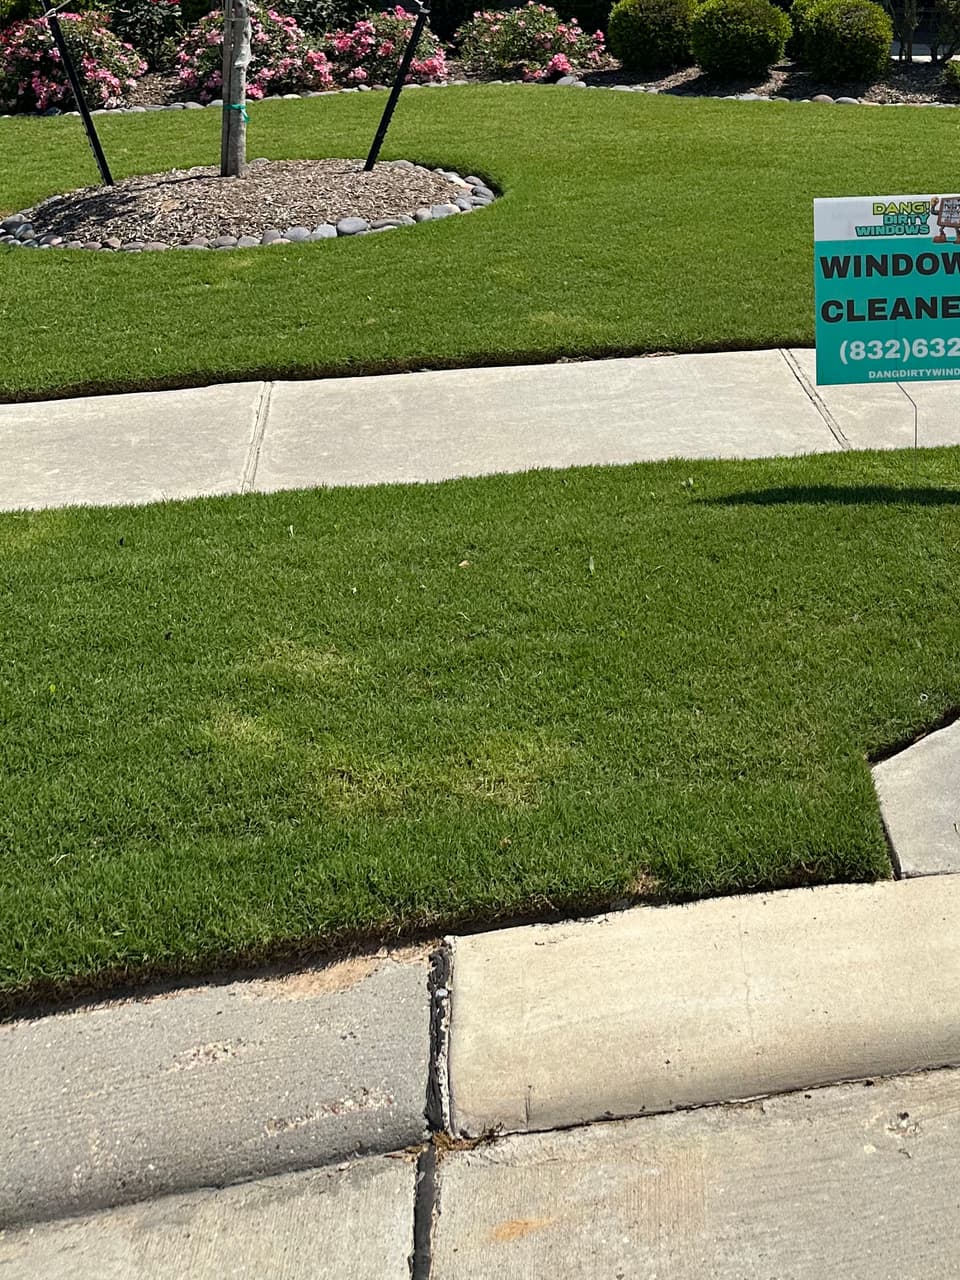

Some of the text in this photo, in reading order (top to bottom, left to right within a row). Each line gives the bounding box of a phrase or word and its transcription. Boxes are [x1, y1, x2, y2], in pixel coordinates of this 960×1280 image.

[873, 201, 930, 215] DANG!
[883, 213, 930, 225] DIRTY
[855, 224, 930, 237] WINDOWS
